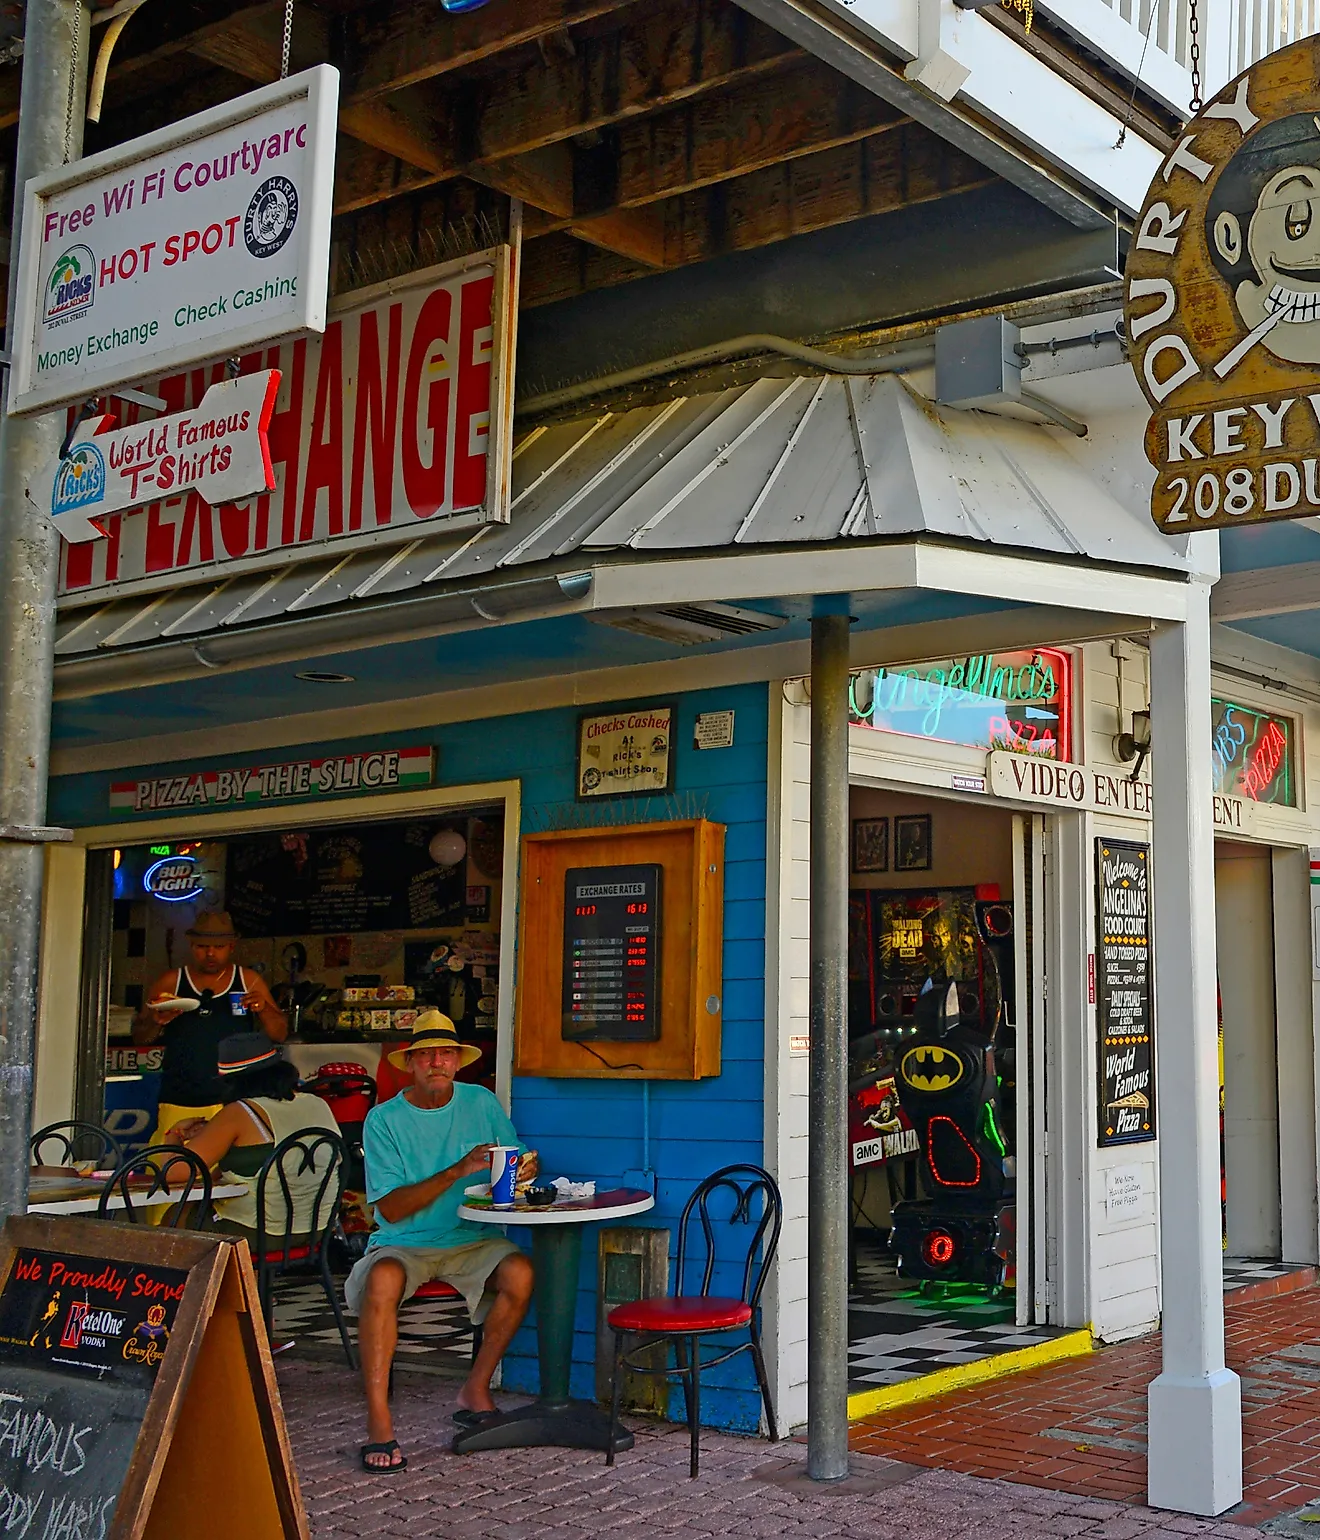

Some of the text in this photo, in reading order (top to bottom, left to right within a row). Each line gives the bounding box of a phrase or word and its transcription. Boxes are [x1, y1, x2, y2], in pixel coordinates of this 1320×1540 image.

[44, 203, 96, 242] Free
[103, 179, 135, 218] Wi
[142, 169, 166, 204] Fi
[246, 187, 264, 244] DURTY
[99, 216, 241, 287] HOT SPOT
[1130, 75, 1260, 403] DURTY
[37, 342, 83, 373] Money
[87, 320, 159, 356] Exchange
[174, 297, 228, 327] Check
[109, 410, 250, 470] World Famous
[1165, 398, 1302, 464] KEY
[120, 444, 232, 499] T-Shirts
[1164, 470, 1253, 523] 208
[587, 715, 670, 738] Checks Cashed
[989, 716, 1056, 757] PIZZA
[1010, 758, 1086, 802] VIDEO
[1241, 721, 1288, 801] PIZZA
[135, 751, 400, 812] PIZZA BY THE SLICE
[158, 865, 192, 879] BUD
[579, 883, 642, 897] EXCHANGE RATES
[1103, 853, 1146, 890] Welcome to
[892, 930, 923, 949] DEAD
[1104, 916, 1146, 935] FOOD COURT
[1104, 946, 1118, 960] HAND
[1135, 948, 1147, 961] PIZZA
[1111, 991, 1123, 1007] DAILY
[1106, 1047, 1136, 1079] World
[1115, 1069, 1149, 1099] Famous
[1116, 1108, 1140, 1133] Pizza
[508, 1169, 517, 1198] pepsi
[15, 1257, 186, 1300] We Proudly Serve
[81, 1335, 106, 1348] VODKA
[122, 1337, 165, 1366] Crown Roya
